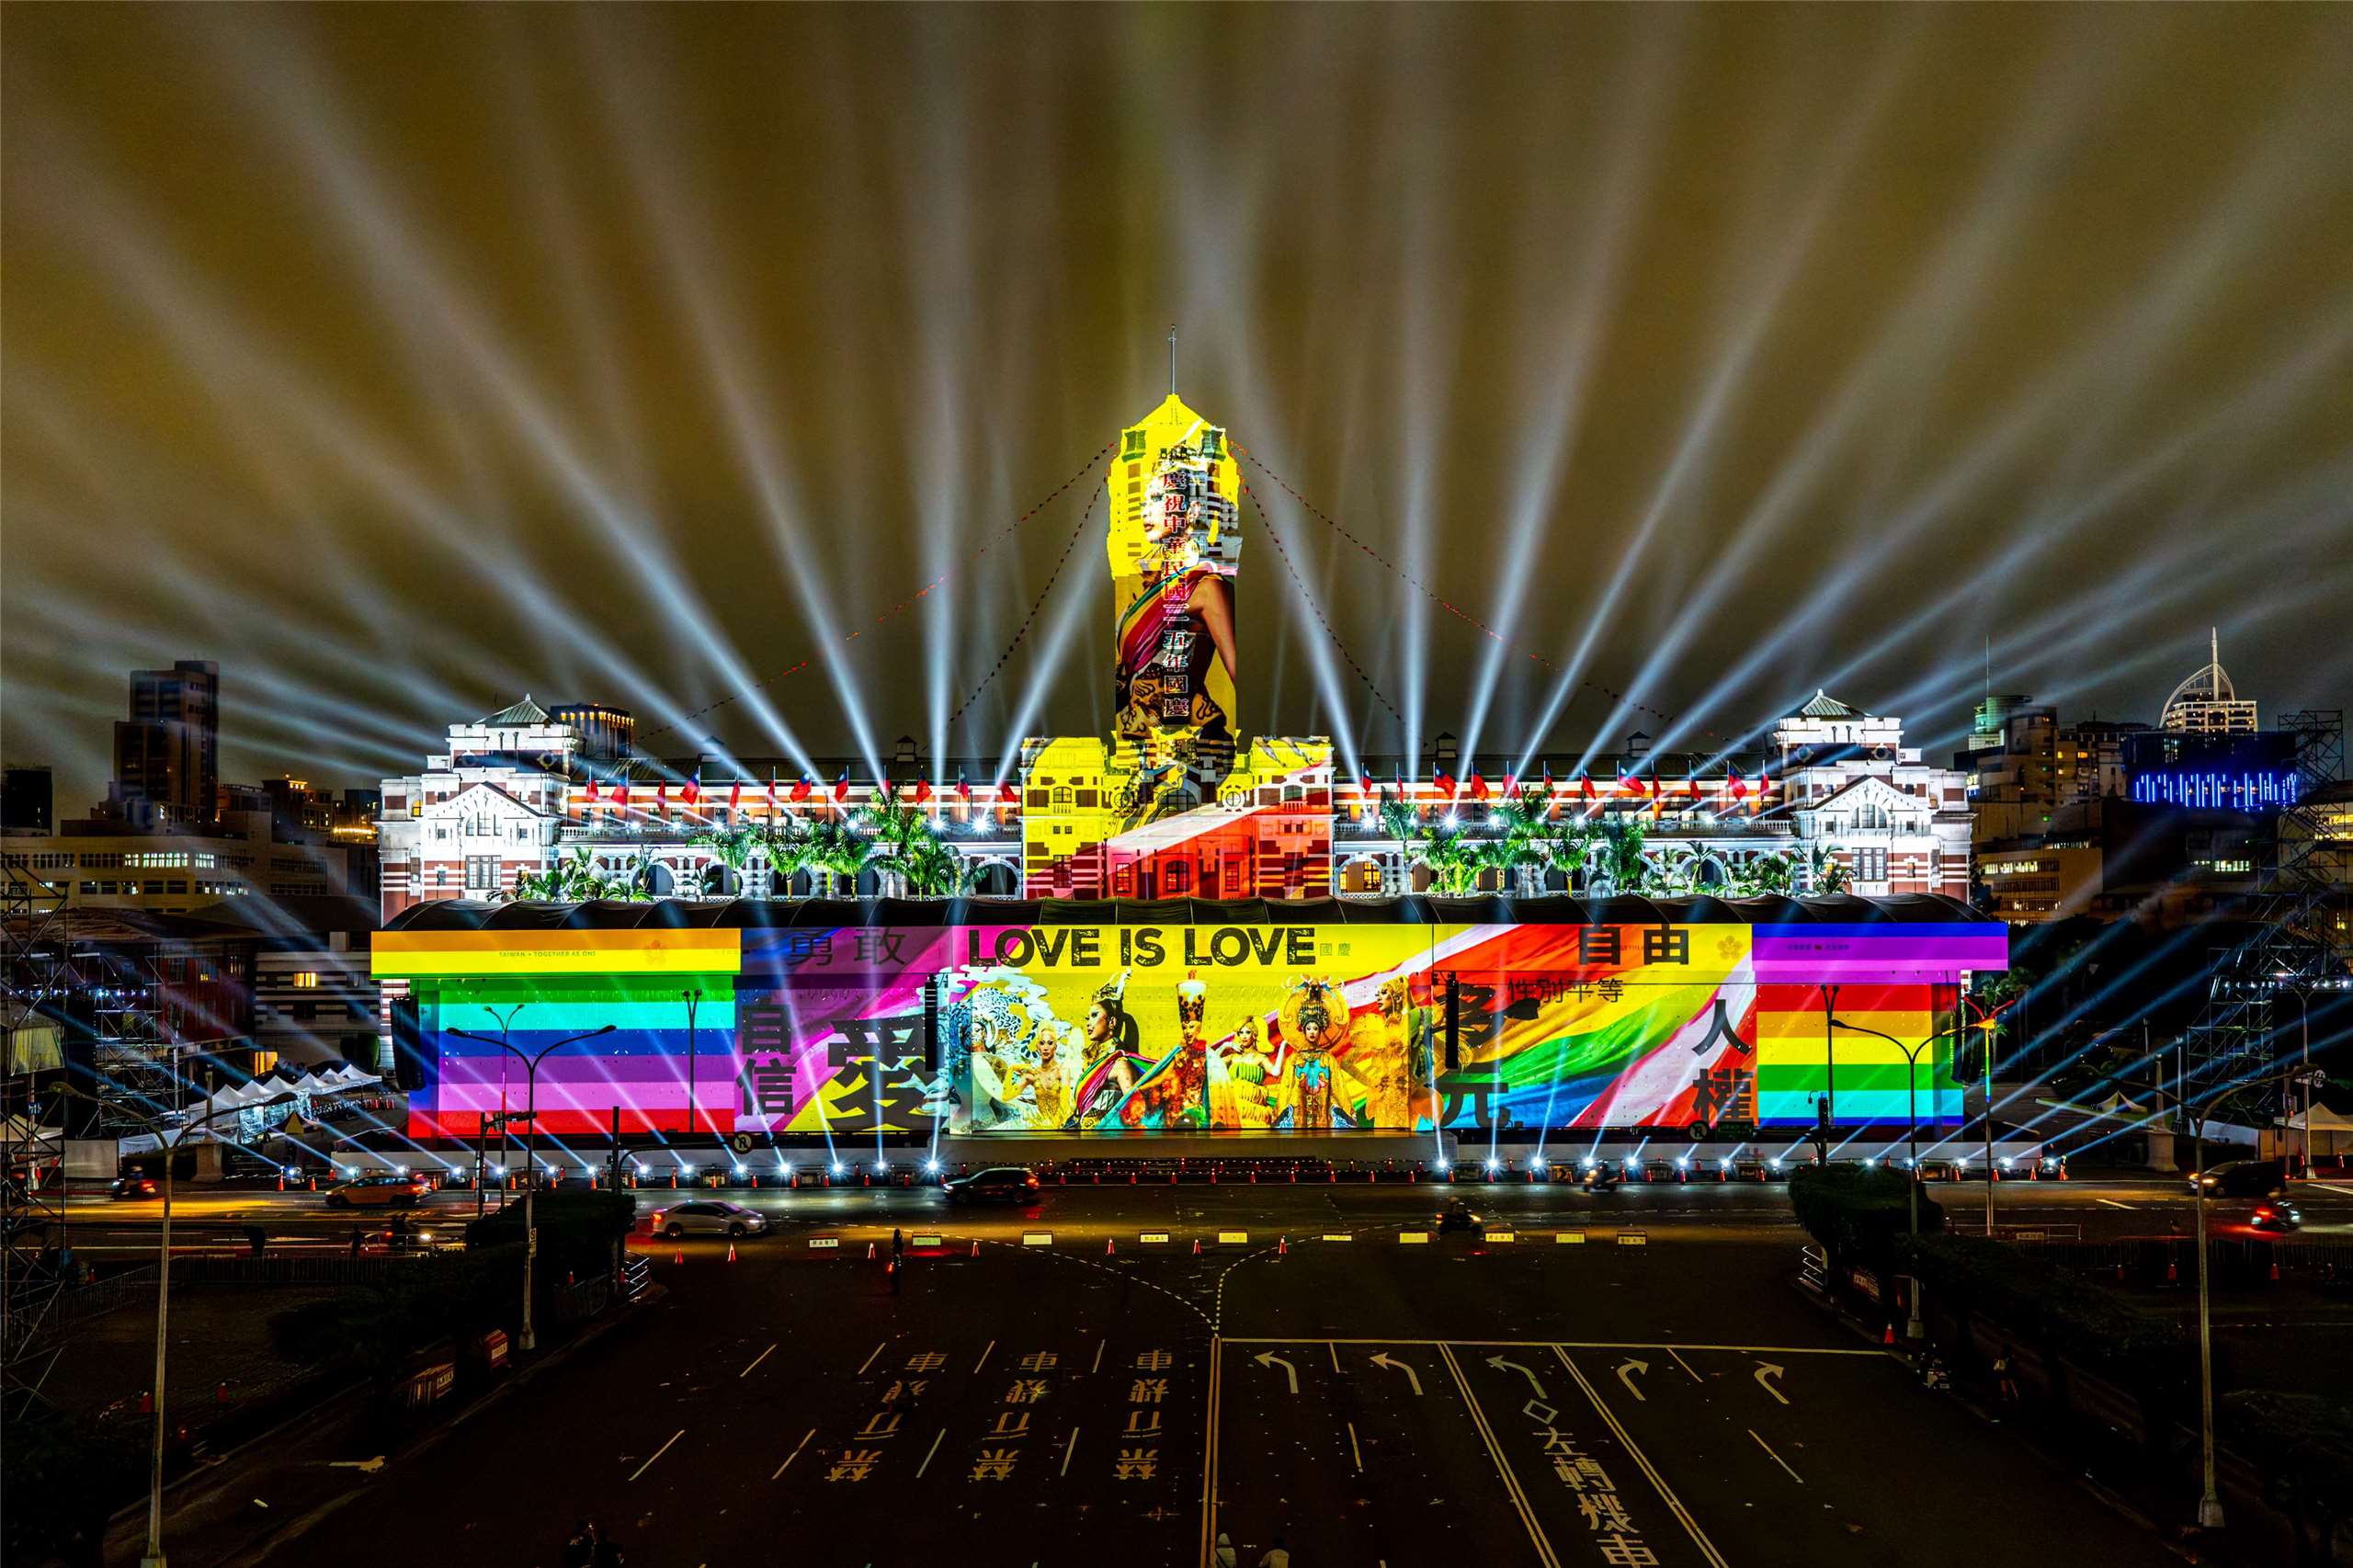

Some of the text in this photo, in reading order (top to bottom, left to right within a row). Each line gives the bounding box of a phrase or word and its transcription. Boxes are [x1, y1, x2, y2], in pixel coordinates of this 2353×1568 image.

[790, 927, 905, 965] 勇敢
[970, 926, 1316, 967] LOVE IS LOVE
[1507, 978, 1624, 1004] 性別平等
[1579, 923, 1689, 965] 自由
[736, 997, 797, 1117] 自信
[827, 1014, 949, 1131] 愛
[1692, 999, 1754, 1125] 人權
[968, 1350, 1058, 1481] 禁行機車
[1113, 1349, 1173, 1480] 禁行機車
[1532, 1426, 1660, 1568] 左轉機車
